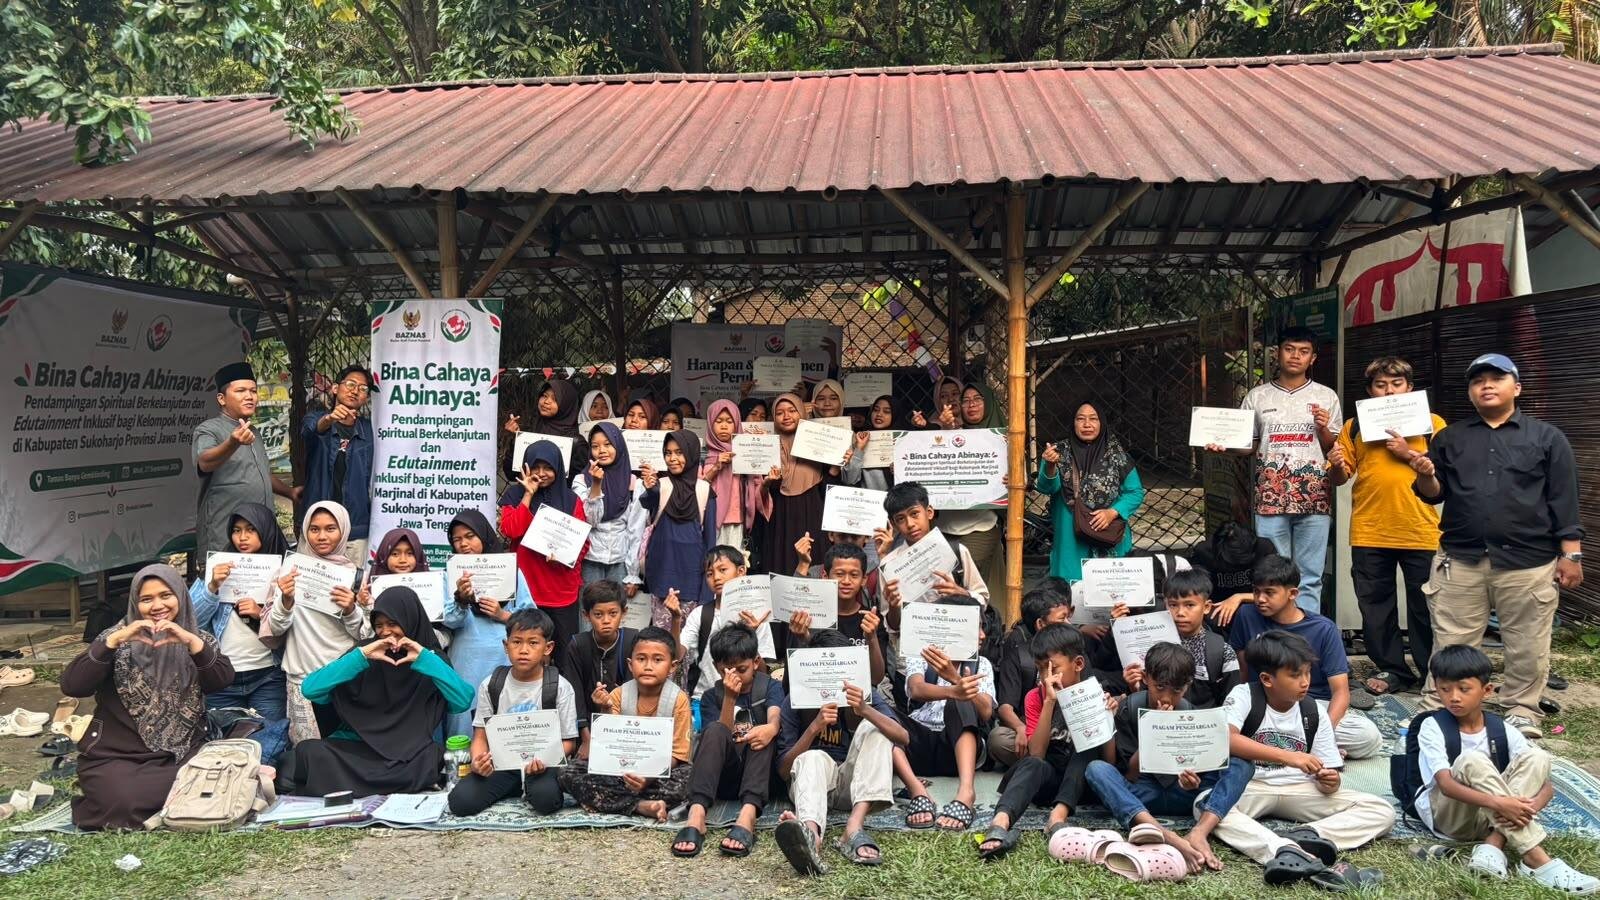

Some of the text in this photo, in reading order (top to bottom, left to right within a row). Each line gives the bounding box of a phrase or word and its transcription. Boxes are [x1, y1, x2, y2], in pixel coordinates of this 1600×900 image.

[101, 335, 127, 344] BAZNAS
[688, 358, 743, 371] Harapan
[35, 362, 206, 396] Bina Cahaya Abinaya:
[381, 362, 490, 386] Bina Cahaya
[25, 395, 205, 412] Pendampingan Spiritual Berkelanjutan dan
[389, 384, 480, 411] Abinaya:
[13, 416, 81, 431] Edutainment
[83, 414, 115, 429] Inklusif
[117, 414, 135, 430] bagi
[137, 414, 176, 429] Kelompok
[391, 414, 473, 428] Pendampingan
[258, 424, 288, 437] ET'S
[378, 428, 490, 442] Spiritual Berkelanjutan
[13, 431, 193, 454] di Kabupaten Sukoharjo Provinsi Jawa Teng
[421, 442, 441, 453] dan
[387, 456, 477, 471] Edutainment
[375, 473, 490, 488] nklusif bagi Kelompok
[374, 488, 488, 503] Marjinal di Kabupaten
[381, 503, 434, 517] Sukoharjo
[397, 518, 450, 532] Jawa Teng
